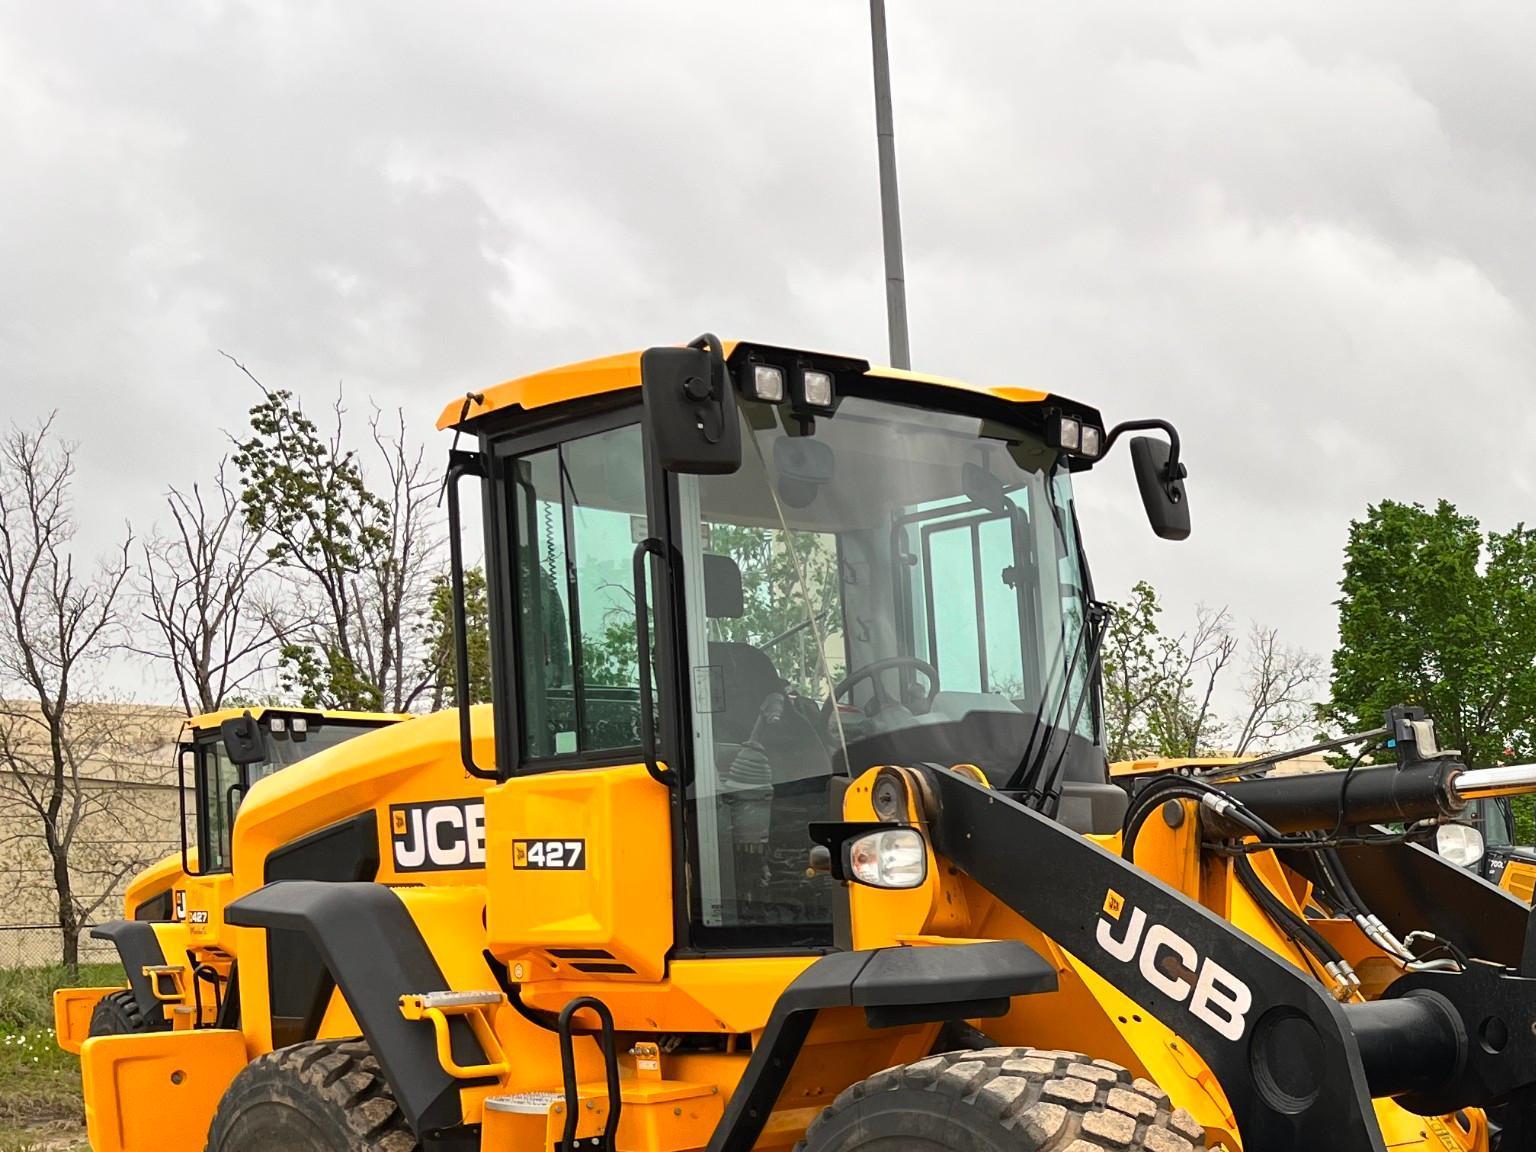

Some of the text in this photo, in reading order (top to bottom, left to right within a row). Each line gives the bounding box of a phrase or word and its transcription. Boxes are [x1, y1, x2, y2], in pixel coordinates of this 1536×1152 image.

[527, 842, 582, 867] 427
[192, 912, 208, 922] 427
[1096, 906, 1252, 1041] JCB
